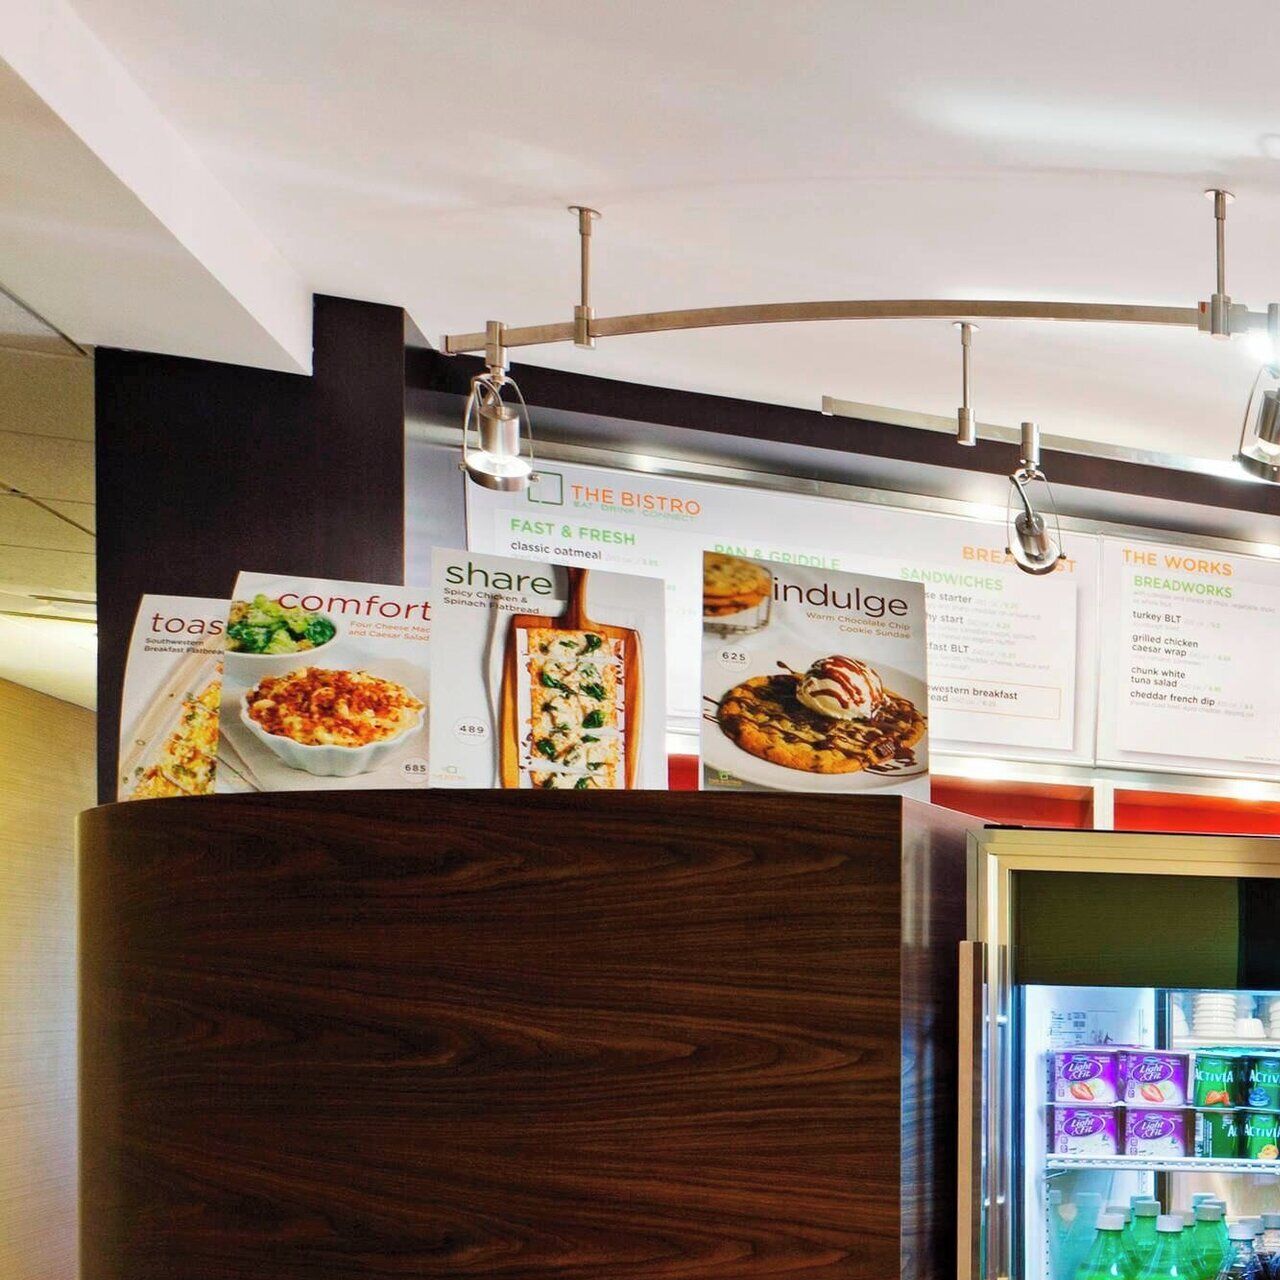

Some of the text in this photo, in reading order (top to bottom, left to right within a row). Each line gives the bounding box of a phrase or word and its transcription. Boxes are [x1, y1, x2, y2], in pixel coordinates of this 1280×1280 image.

[571, 485, 701, 516] THE BISTRO
[511, 519, 636, 546] FAST & FRESH
[511, 540, 550, 554] classic
[554, 546, 602, 561] oatmeal
[769, 551, 841, 570] GRIDDLE
[963, 546, 1077, 574] BREAST
[1122, 548, 1233, 577] THE WORKS
[446, 561, 553, 595] share
[900, 567, 1004, 591] SANDWICHES
[1133, 575, 1233, 599] BREADWORKS
[444, 587, 473, 598] Spicy
[476, 591, 518, 604] Chicken
[773, 577, 908, 618] indulge
[939, 593, 972, 604] starter
[278, 593, 431, 622] comfort
[444, 597, 540, 615] Spinach Flatbread
[152, 612, 224, 636] toas
[806, 611, 911, 631] Warm Chocolate Chip
[941, 613, 964, 624] start
[1132, 610, 1182, 623] turkey BLT
[839, 625, 911, 639] Cookie Sundae
[145, 637, 204, 646] Southwestern
[1132, 633, 1198, 649] grilled chicken
[722, 651, 745, 661] 625
[951, 644, 970, 654] BLT
[1132, 644, 1187, 658] caesar wrap
[1131, 666, 1186, 680] chunk white
[1131, 676, 1178, 688] tuna salad
[972, 688, 1018, 700] breakfast
[1130, 690, 1215, 706] cheddar french dip
[459, 725, 484, 735] 489
[405, 763, 426, 773] 685
[1069, 1062, 1092, 1074] Light
[1140, 1063, 1163, 1075] Light
[1195, 1068, 1234, 1083] ACTIVIA
[1071, 1117, 1094, 1129] Light
[1142, 1119, 1164, 1131] Light
